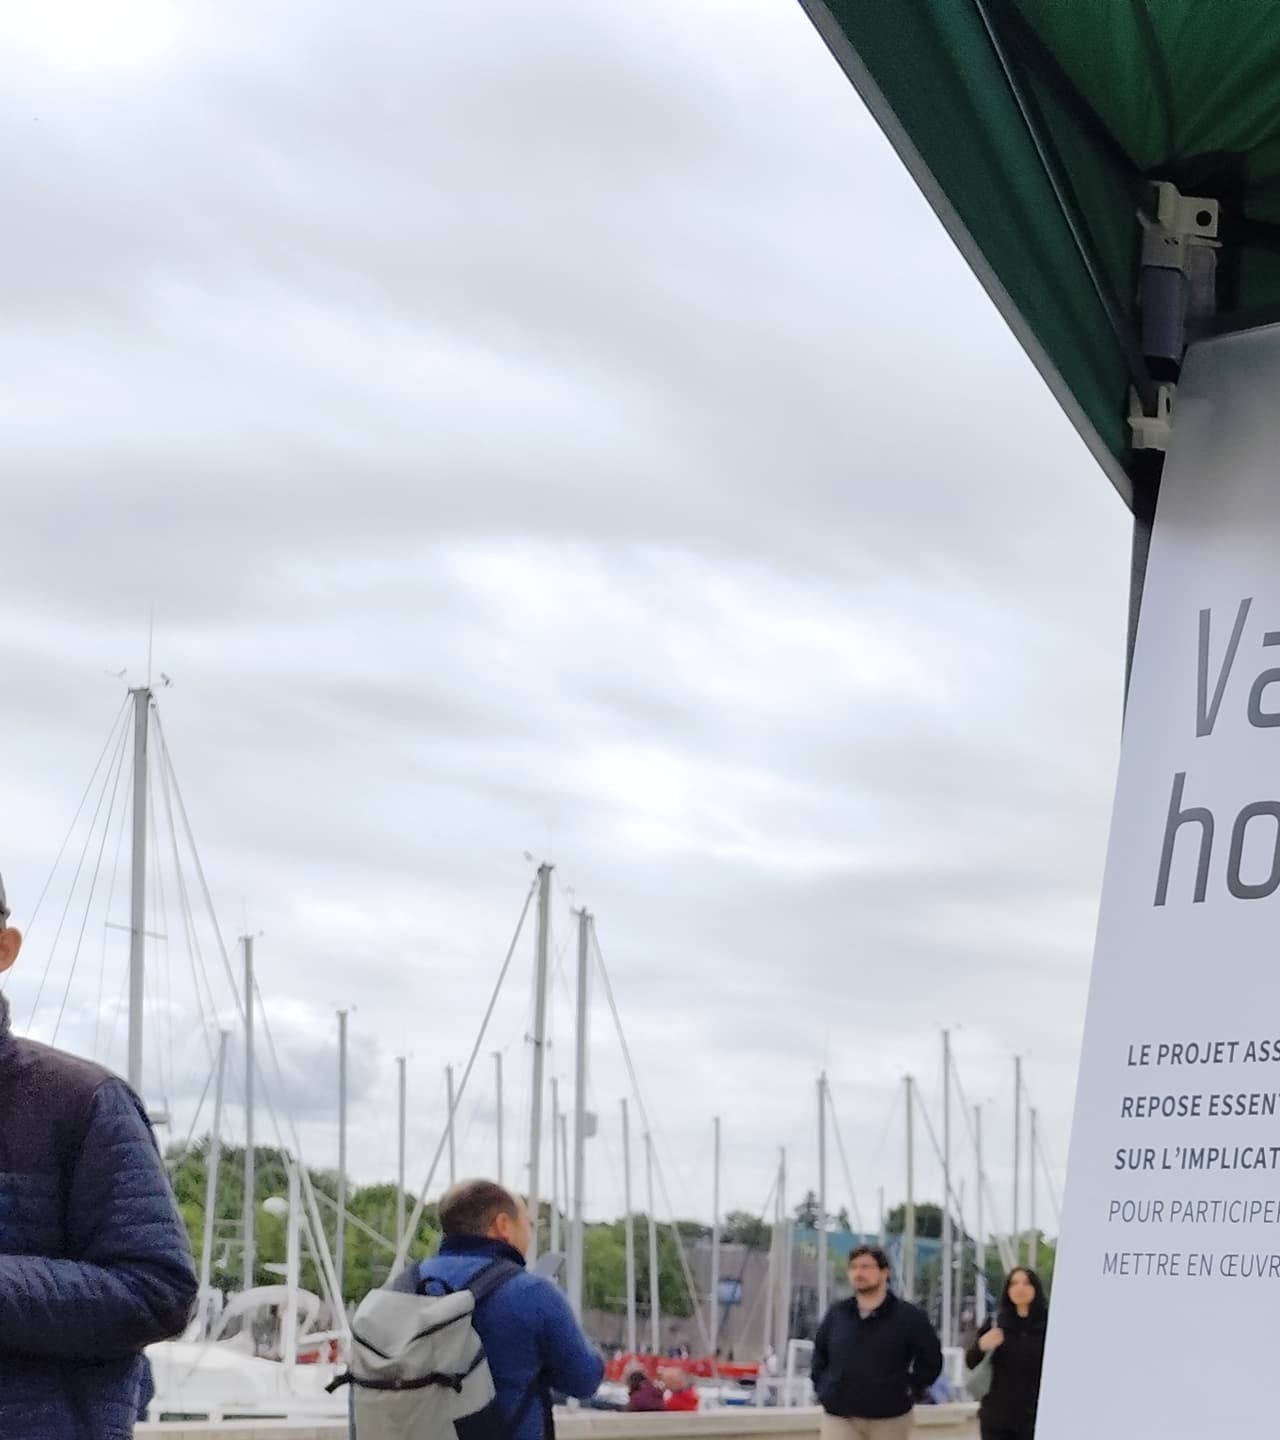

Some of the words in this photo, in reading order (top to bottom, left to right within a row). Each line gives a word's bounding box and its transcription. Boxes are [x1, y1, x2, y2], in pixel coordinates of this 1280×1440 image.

[1127, 1044, 1152, 1067] LE
[1157, 1040, 1240, 1066] PROJET
[1121, 1095, 1202, 1118] REPOSE
[1114, 1148, 1155, 1170] SUR
[1108, 1200, 1164, 1223] POUR
[1102, 1252, 1180, 1276] METTRE
[1187, 1253, 1212, 1277] EN
